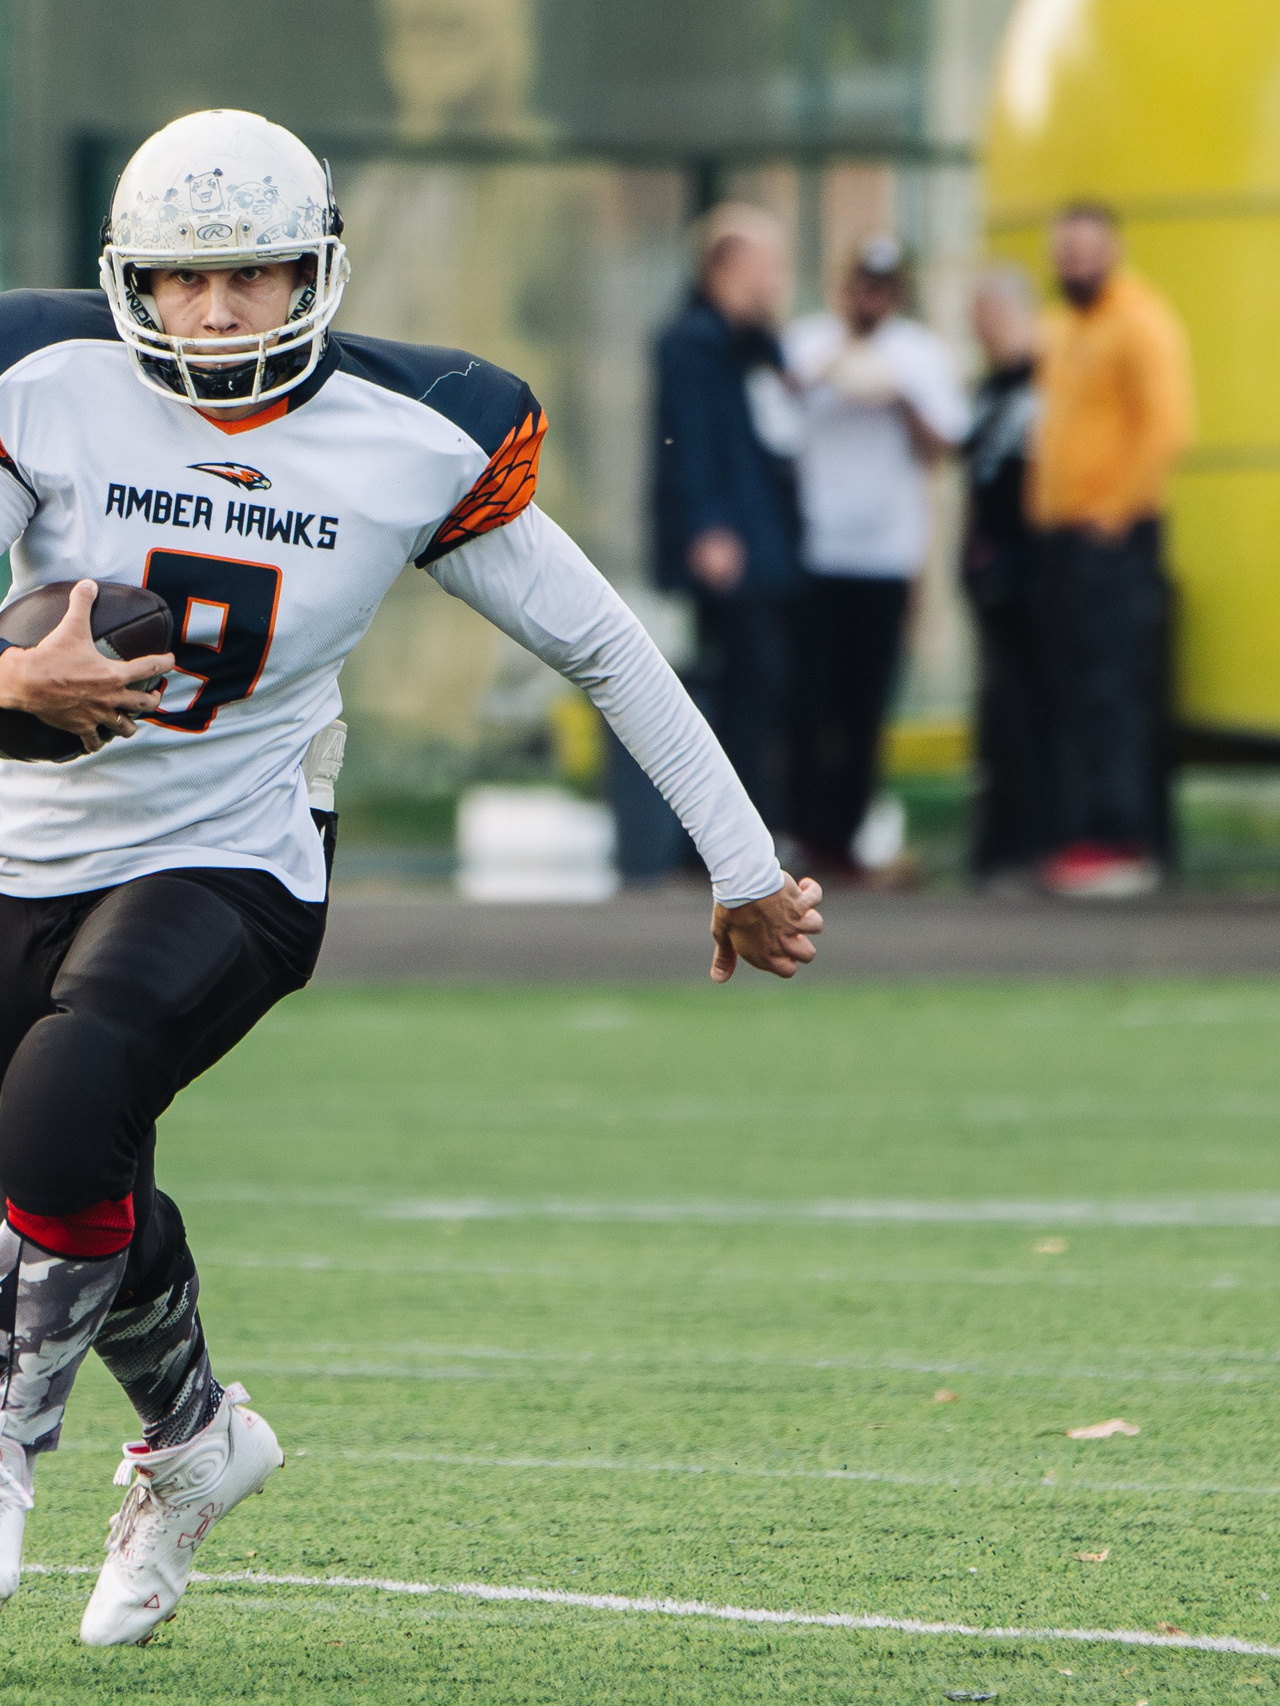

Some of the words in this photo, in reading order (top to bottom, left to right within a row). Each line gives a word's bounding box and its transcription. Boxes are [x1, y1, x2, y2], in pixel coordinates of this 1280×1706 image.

[106, 483, 213, 531] AMBER
[225, 500, 339, 550] HAWKS
[137, 547, 283, 734] 9
